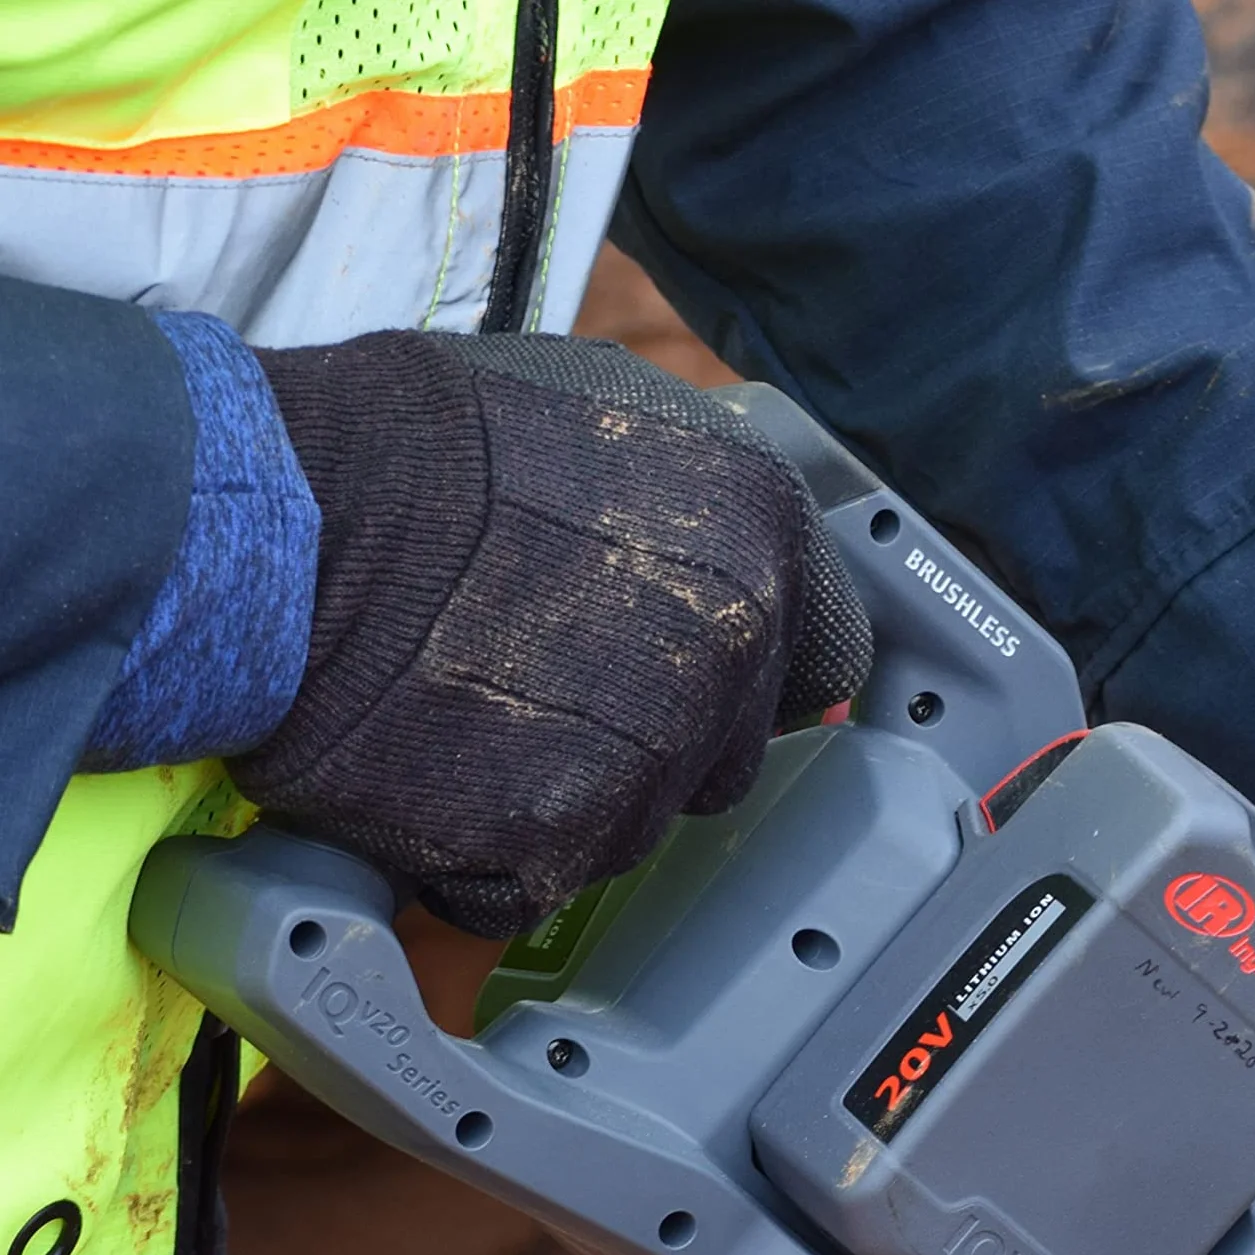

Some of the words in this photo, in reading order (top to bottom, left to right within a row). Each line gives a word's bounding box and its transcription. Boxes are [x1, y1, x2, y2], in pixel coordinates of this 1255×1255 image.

[904, 548, 1020, 657] BRUSHLESS
[542, 918, 564, 949] ION
[956, 929, 1022, 1003] LITHIUM
[1023, 893, 1055, 925] ION
[386, 1053, 460, 1117] Series
[874, 1011, 954, 1111] 20V
